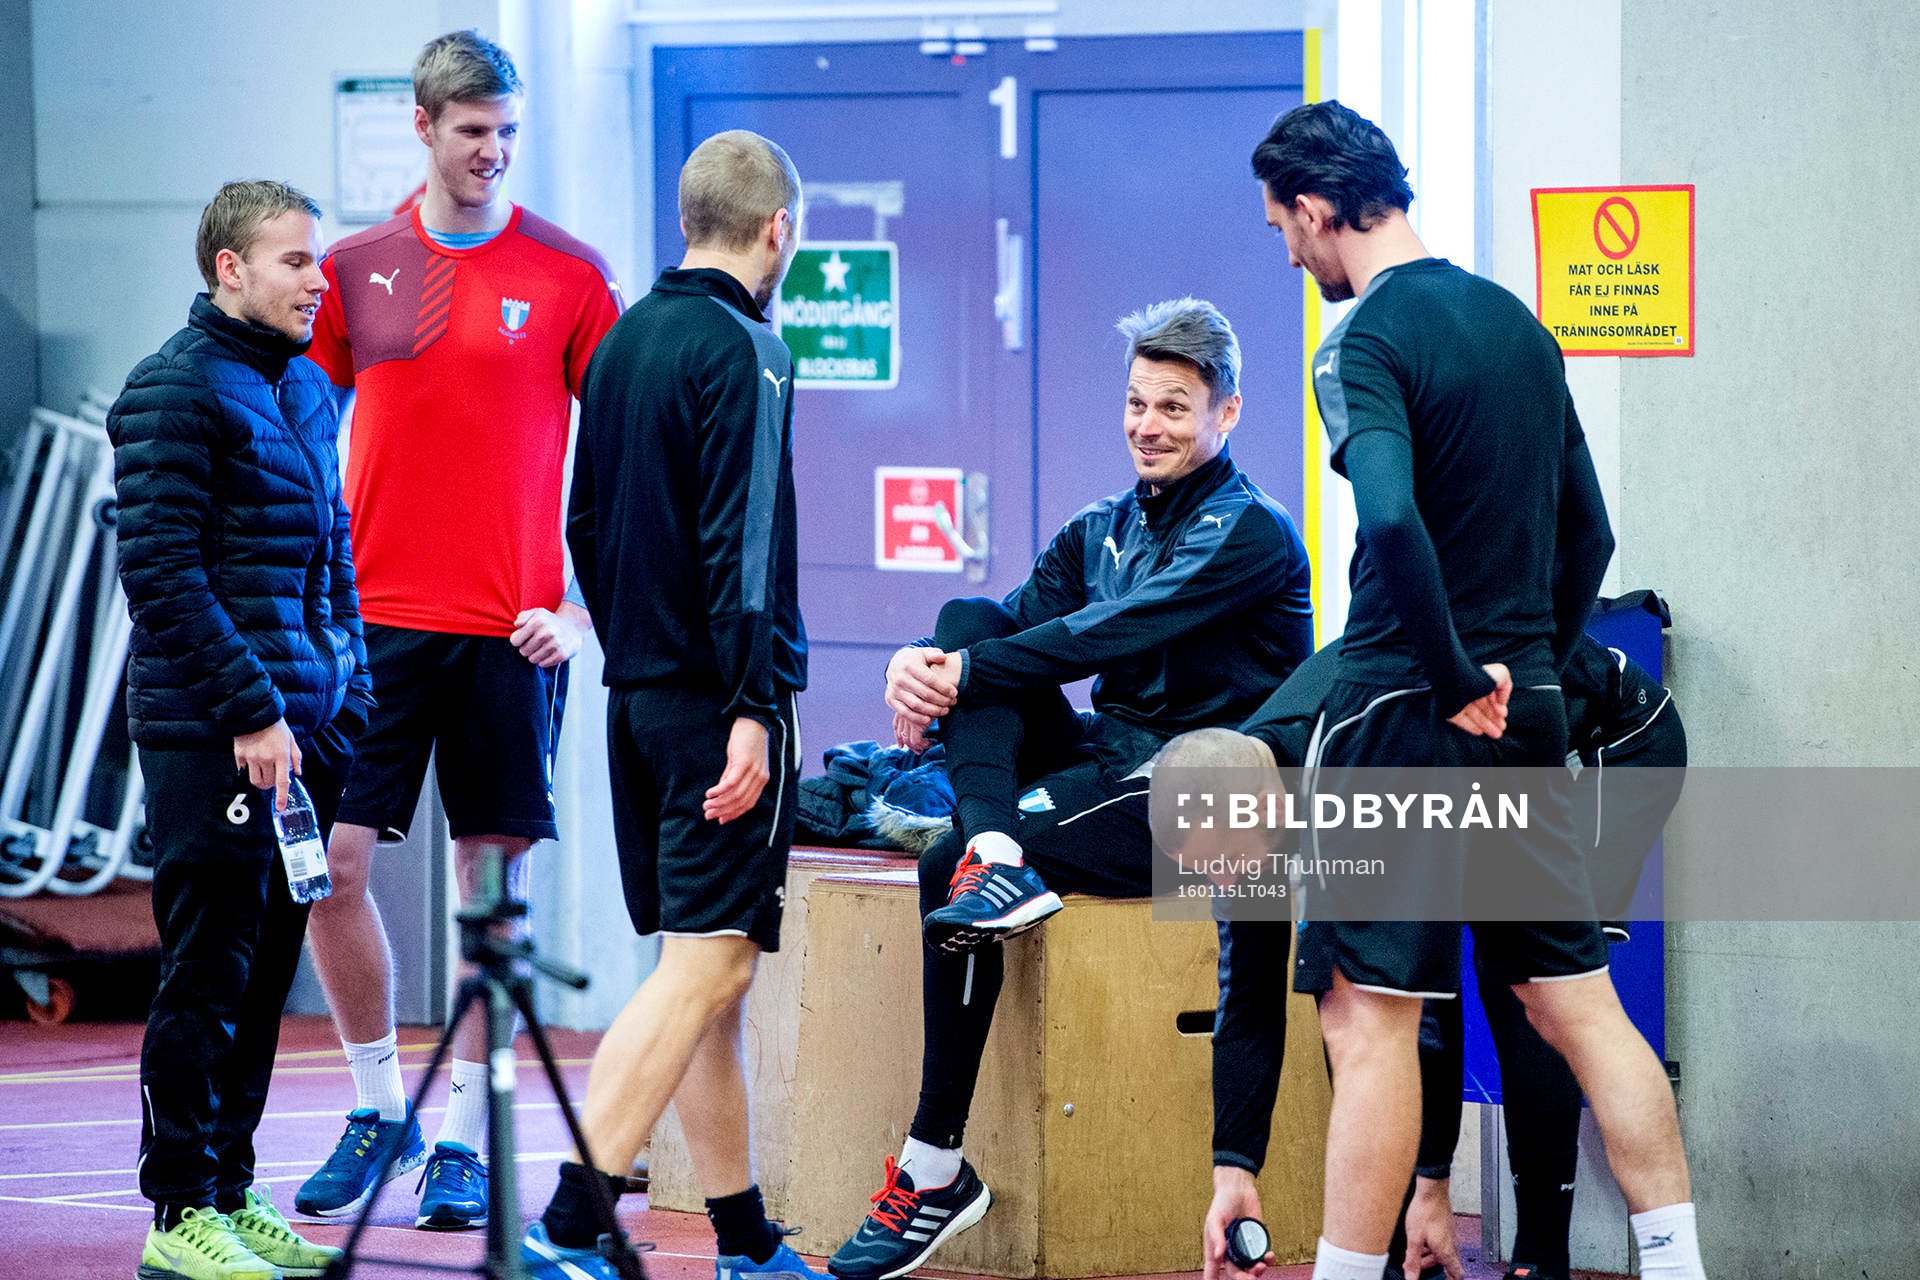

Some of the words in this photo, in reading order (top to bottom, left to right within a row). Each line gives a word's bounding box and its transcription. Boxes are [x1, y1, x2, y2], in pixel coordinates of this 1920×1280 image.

[989, 76, 1017, 159] 1
[1568, 264, 1593, 275] MAT
[1597, 264, 1623, 275] OCH
[1627, 261, 1660, 275] LÄSK
[1569, 282, 1591, 296] FÅR
[1595, 285, 1609, 297] EJ
[1613, 284, 1660, 296] FINNAS
[1589, 305, 1619, 316] INNE
[1623, 302, 1638, 316] PÅ
[1553, 323, 1677, 337] TRÄNINGSOMRÅDET
[226, 793, 250, 825] 6
